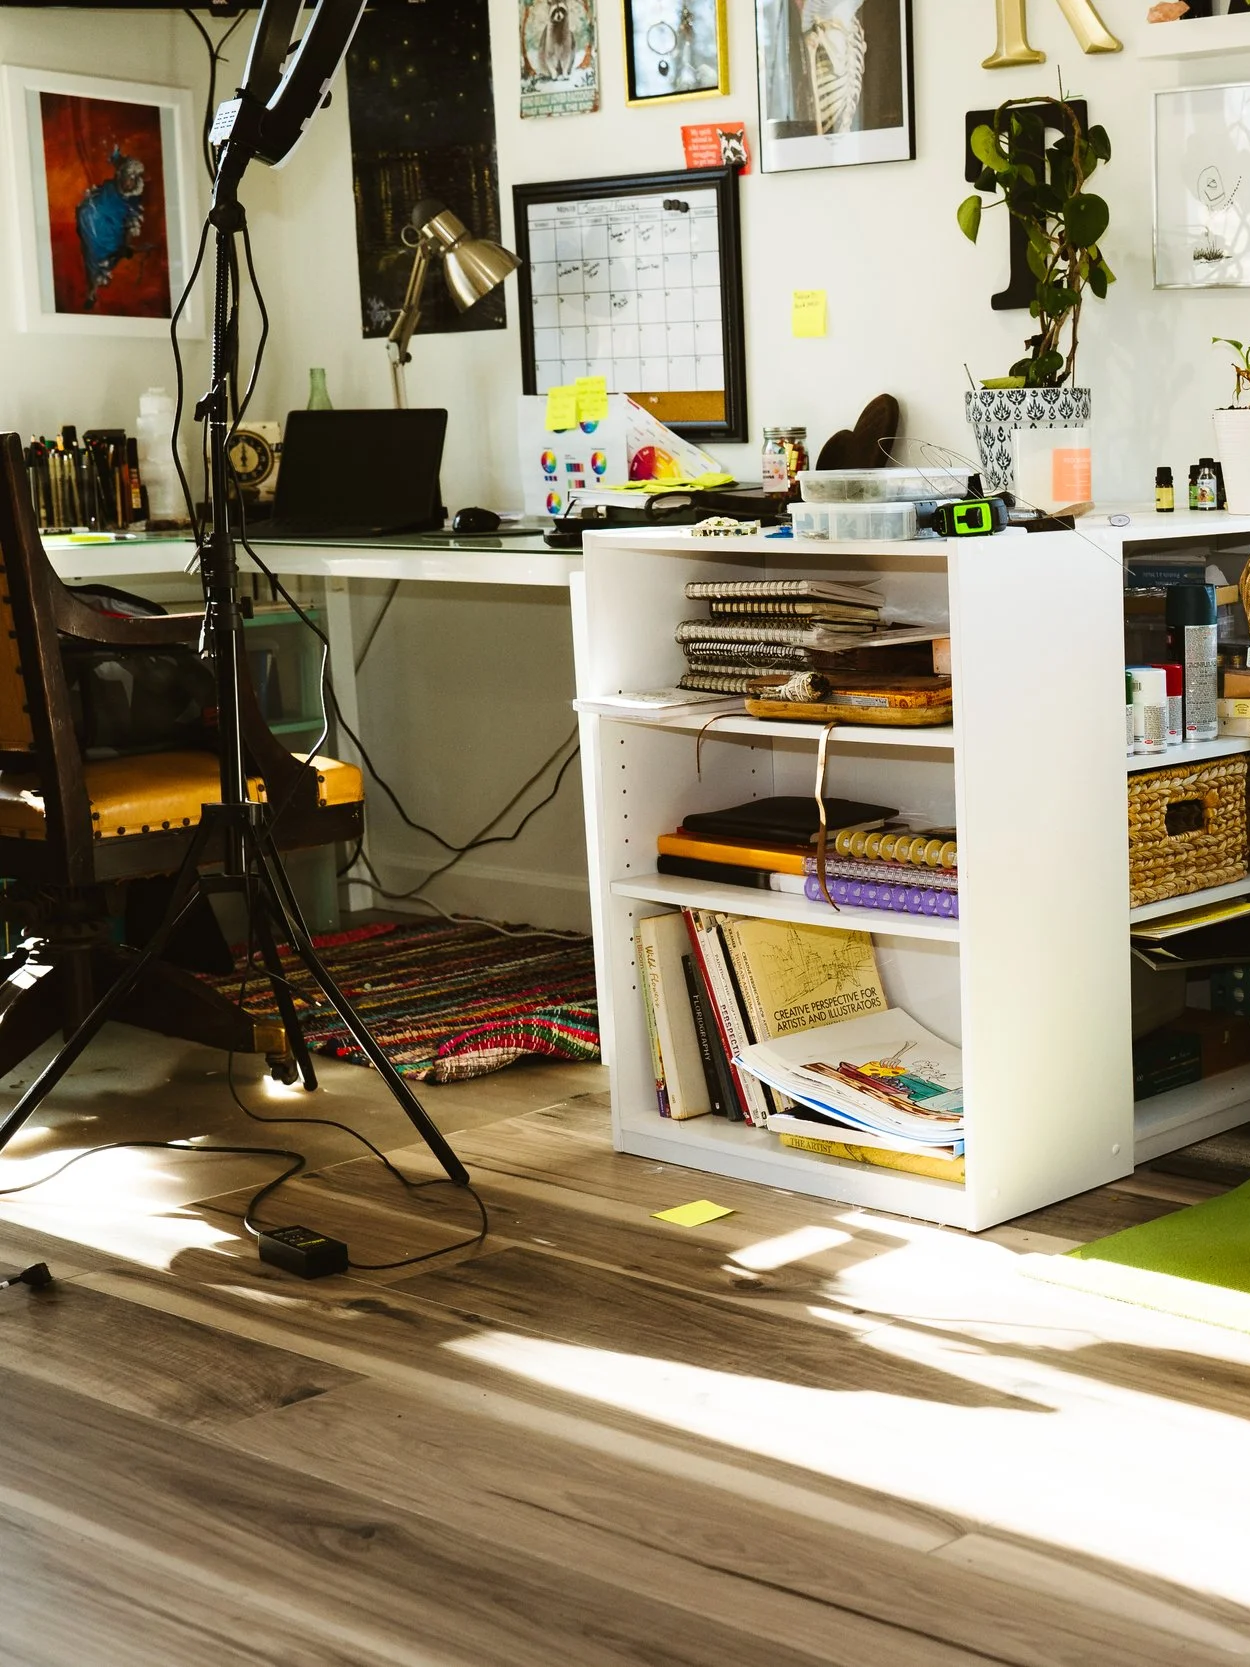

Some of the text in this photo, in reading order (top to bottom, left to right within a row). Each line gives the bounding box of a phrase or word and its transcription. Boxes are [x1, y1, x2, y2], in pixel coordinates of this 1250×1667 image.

[636, 944, 645, 969] Bloom
[645, 945, 654, 970] Wild
[774, 987, 877, 1021] CREATIVE PERSPECTIVE FOR
[777, 1016, 807, 1032] ARTISTS
[808, 1011, 827, 1024] AND
[828, 997, 882, 1019] ILLUSTRATORS
[692, 995, 712, 1062] FLORIOGRAPHY
[720, 1004, 742, 1058] PERSPECTIV
[790, 1137, 806, 1148] THE
[805, 1141, 832, 1154] ARTIST
